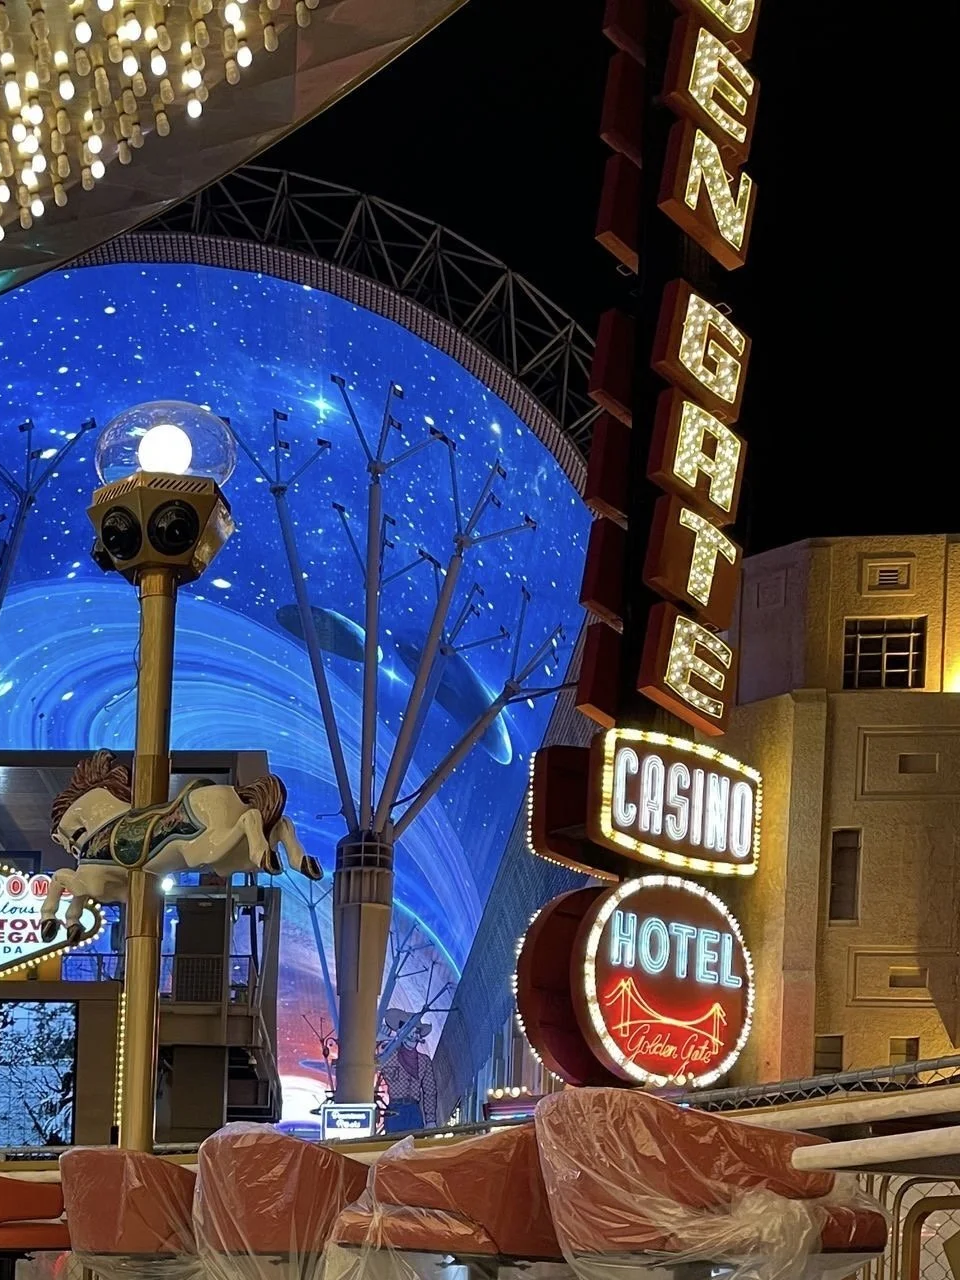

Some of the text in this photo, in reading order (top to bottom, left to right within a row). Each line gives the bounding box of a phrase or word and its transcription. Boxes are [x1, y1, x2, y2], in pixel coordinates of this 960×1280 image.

[664, 292, 746, 720] GATE
[613, 746, 755, 858] CASINO
[608, 909, 744, 988] HOTEL
[626, 1023, 714, 1078] Golden Gate
